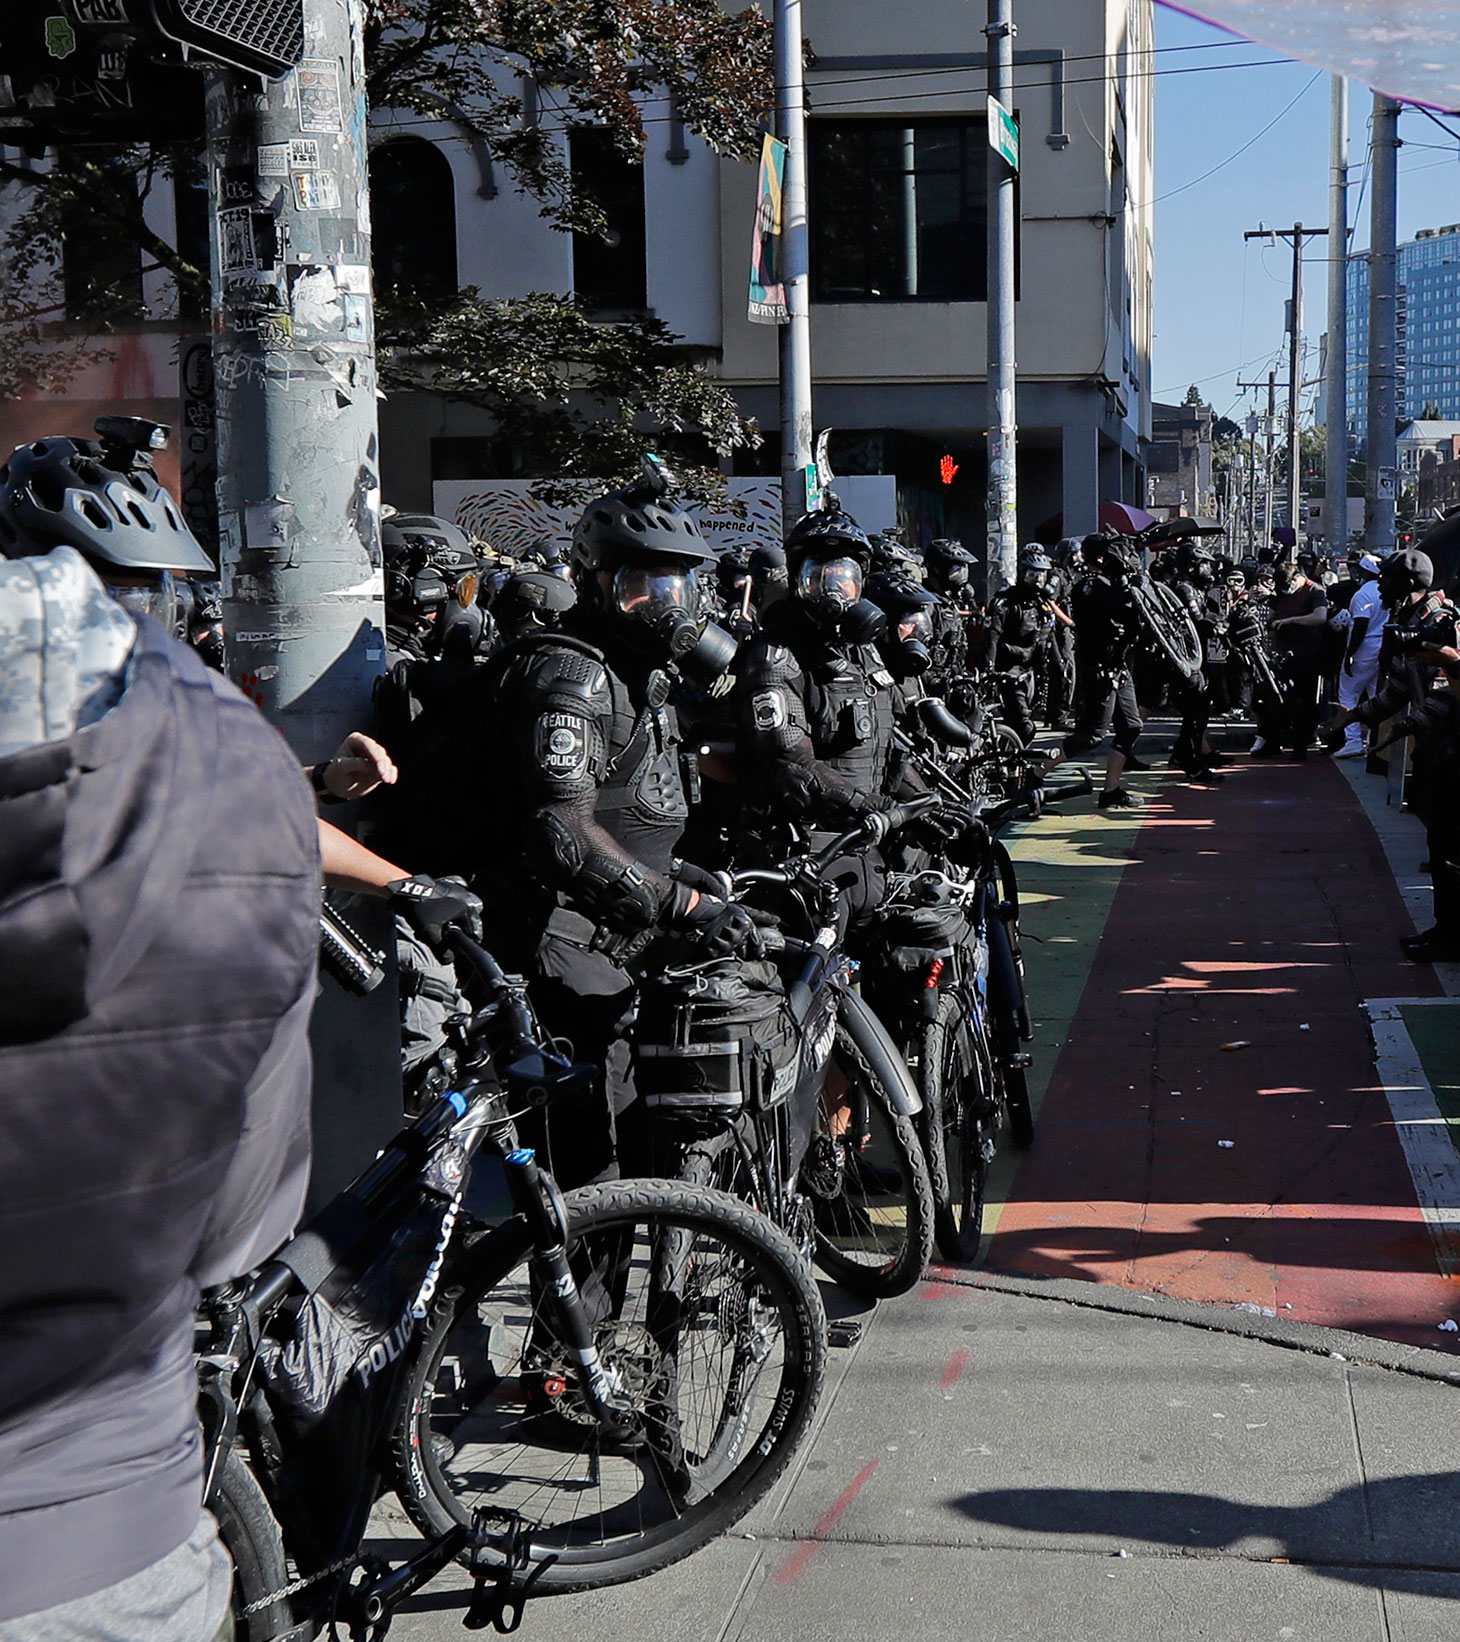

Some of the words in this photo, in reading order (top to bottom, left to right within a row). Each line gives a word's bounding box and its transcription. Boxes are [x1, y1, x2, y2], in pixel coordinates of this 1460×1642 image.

[699, 520, 755, 532] happened
[542, 714, 582, 730] SEATTLE
[545, 754, 578, 767] POLICE
[401, 881, 434, 897] FOX
[759, 1429, 778, 1456] DT
[772, 1388, 795, 1431] SWISS
